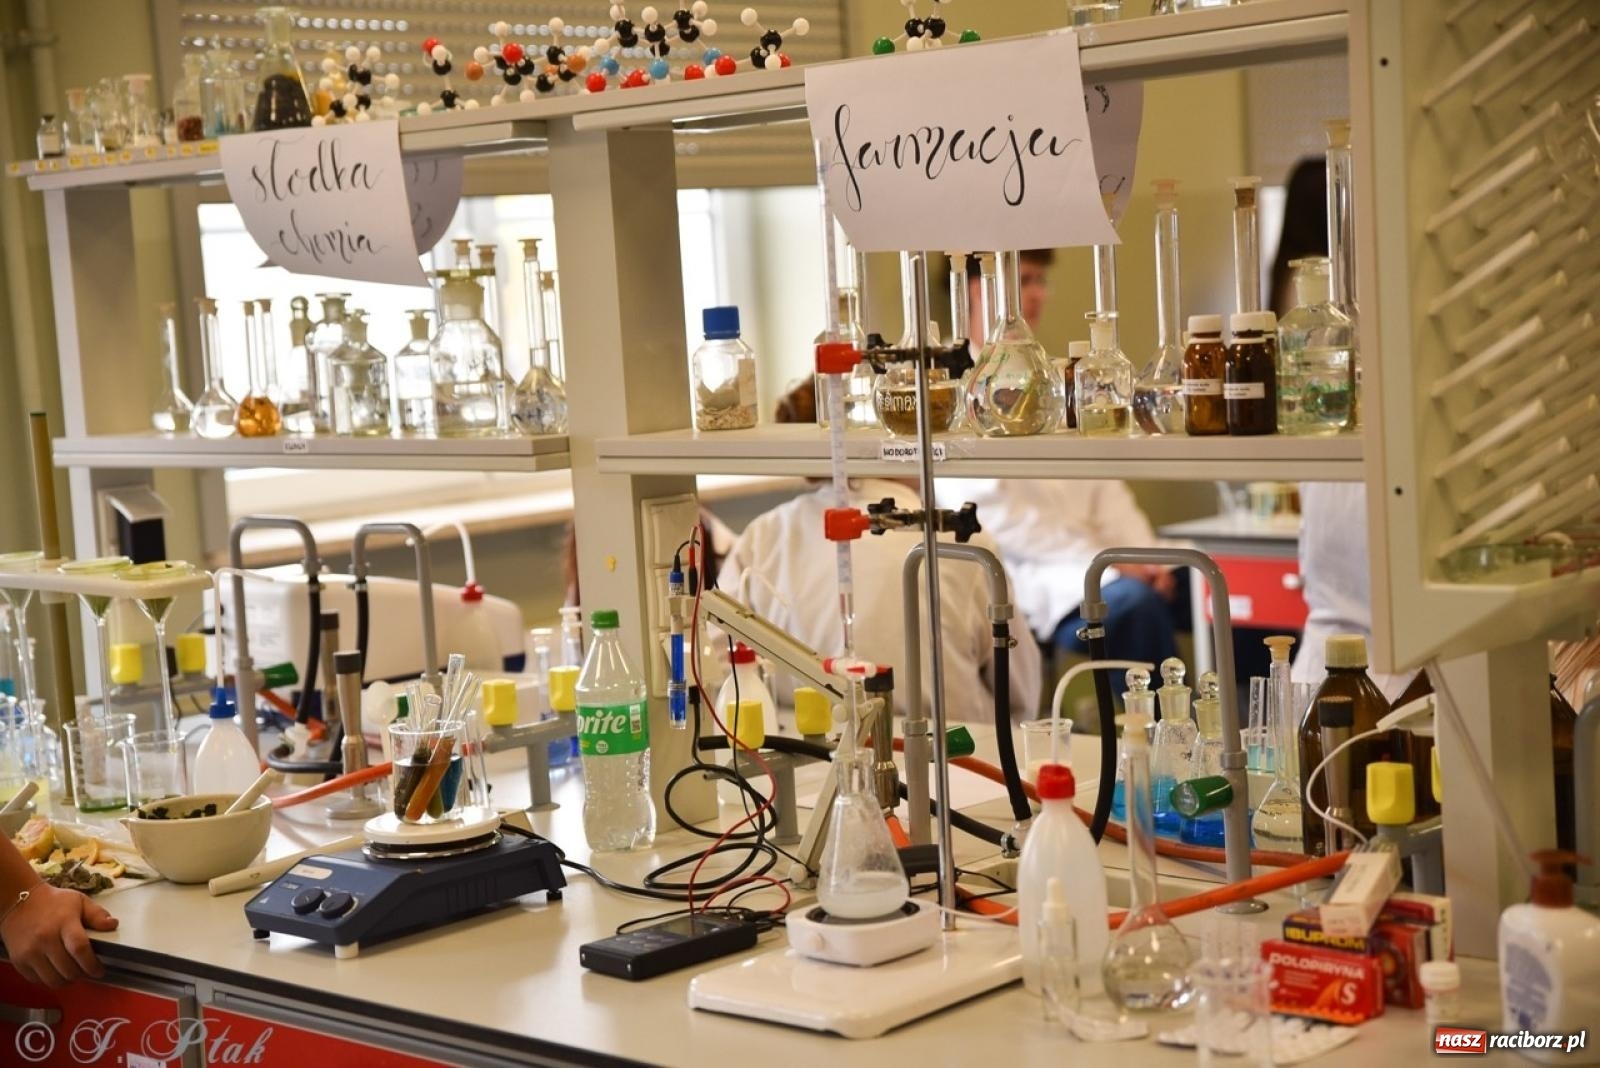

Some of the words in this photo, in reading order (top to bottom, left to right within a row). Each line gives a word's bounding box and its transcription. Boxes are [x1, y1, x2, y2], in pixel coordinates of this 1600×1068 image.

[830, 104, 1083, 212] farmacja
[271, 209, 388, 264] chemia
[576, 709, 627, 737] prite
[1340, 981, 1358, 1006] S
